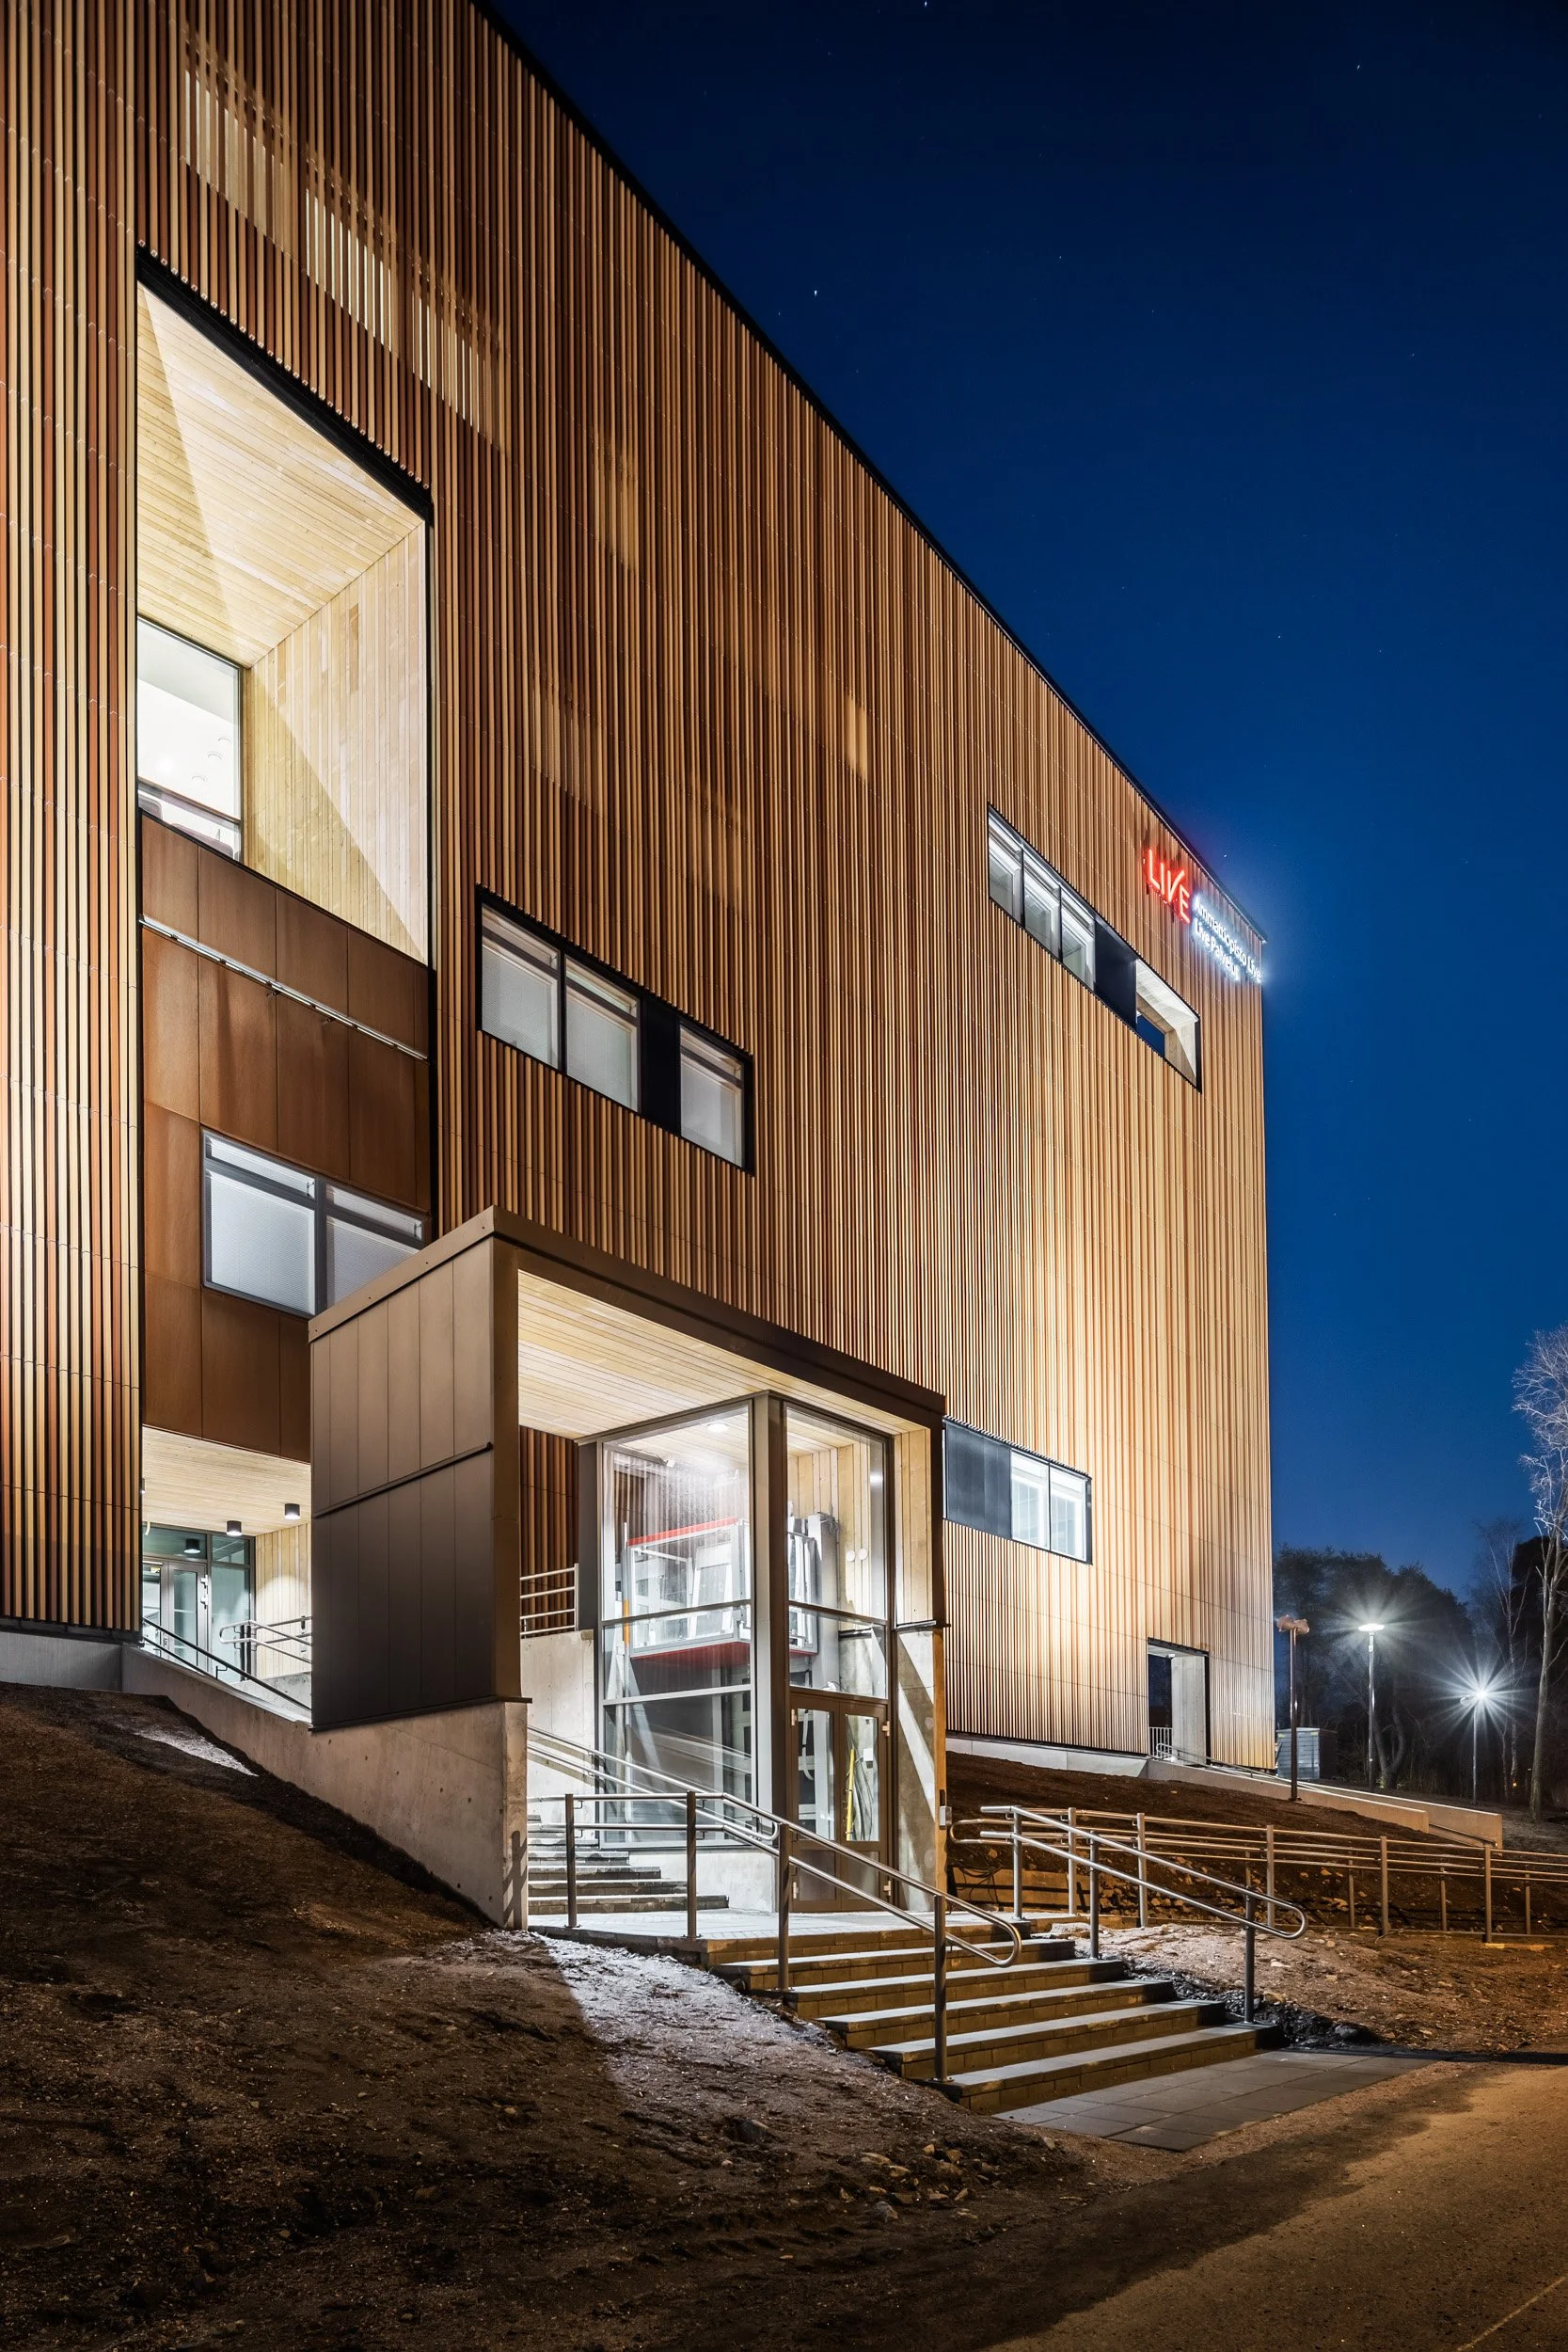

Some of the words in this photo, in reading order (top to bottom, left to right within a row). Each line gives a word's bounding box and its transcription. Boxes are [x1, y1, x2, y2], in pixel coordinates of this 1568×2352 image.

[1148, 849, 1191, 924] LIVE
[1194, 917, 1211, 946] Live
[1247, 955, 1261, 983] Live
